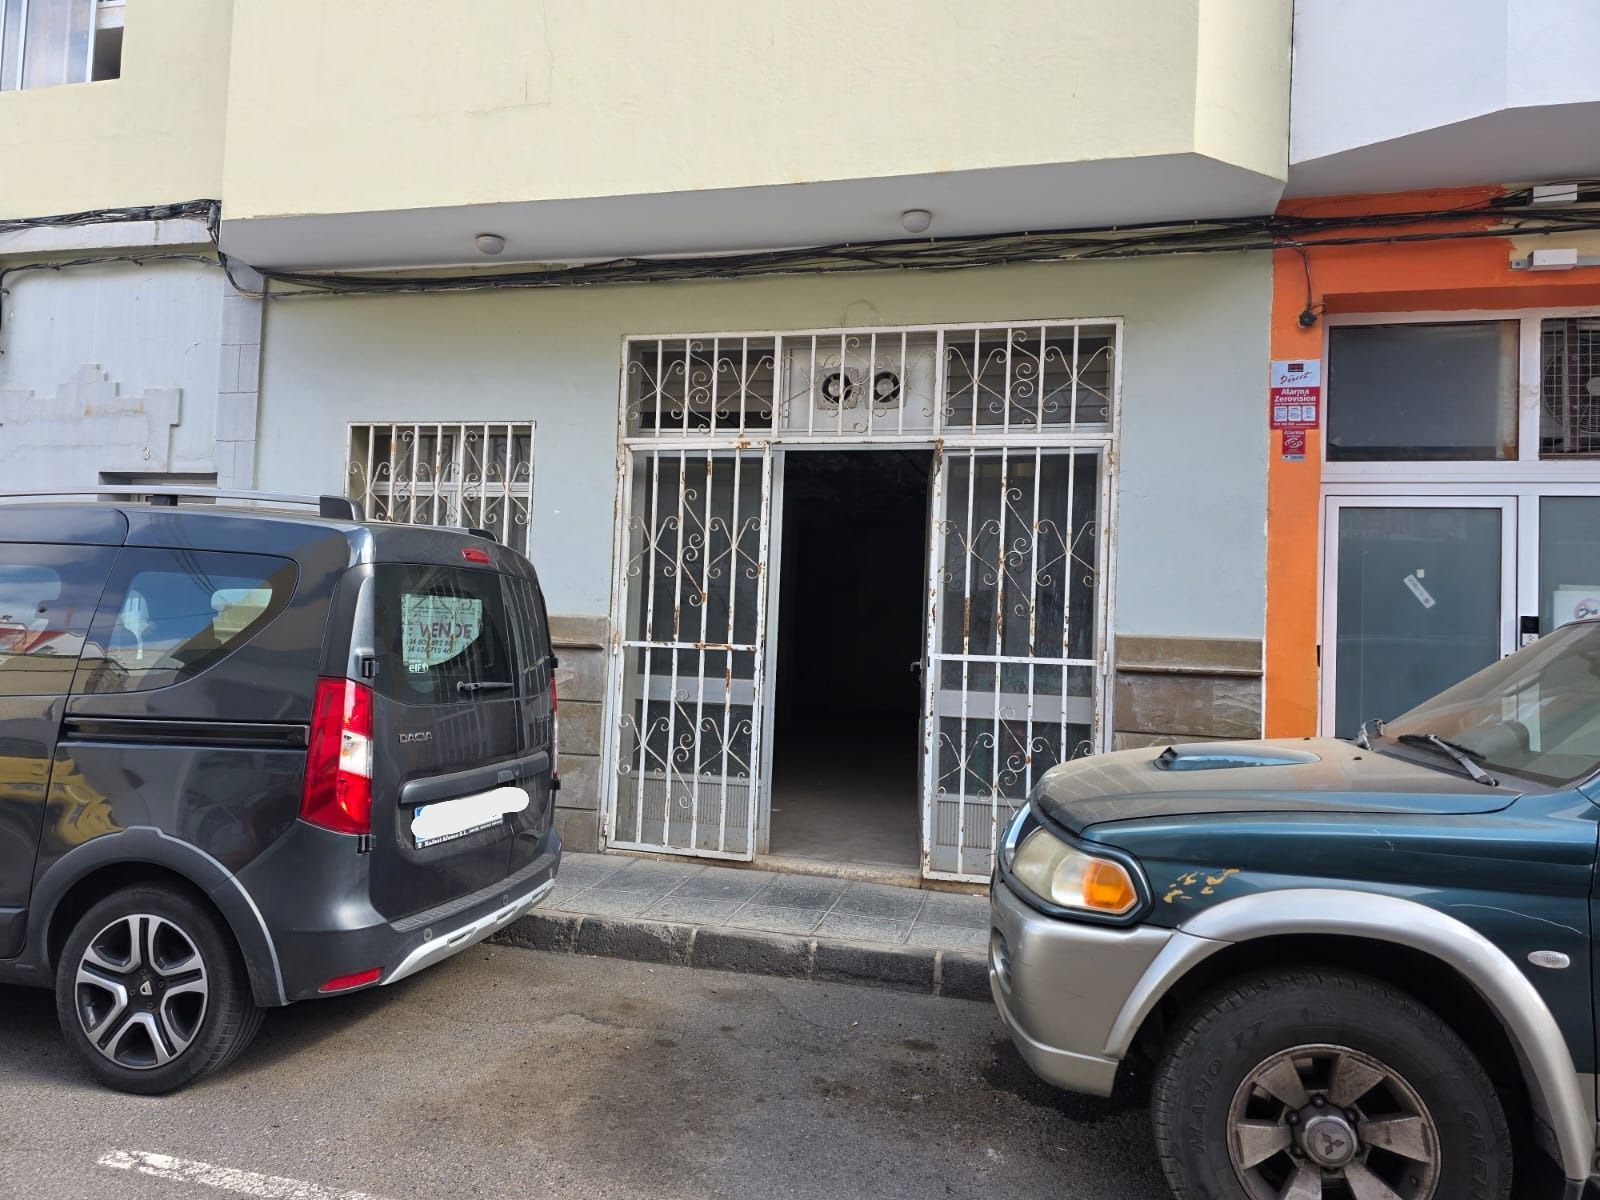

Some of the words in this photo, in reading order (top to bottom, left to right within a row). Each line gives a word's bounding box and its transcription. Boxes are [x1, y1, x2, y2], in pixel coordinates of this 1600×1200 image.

[1274, 395, 1316, 403] Zerovision
[419, 622, 473, 638] VENDE
[399, 731, 433, 744] DACIA
